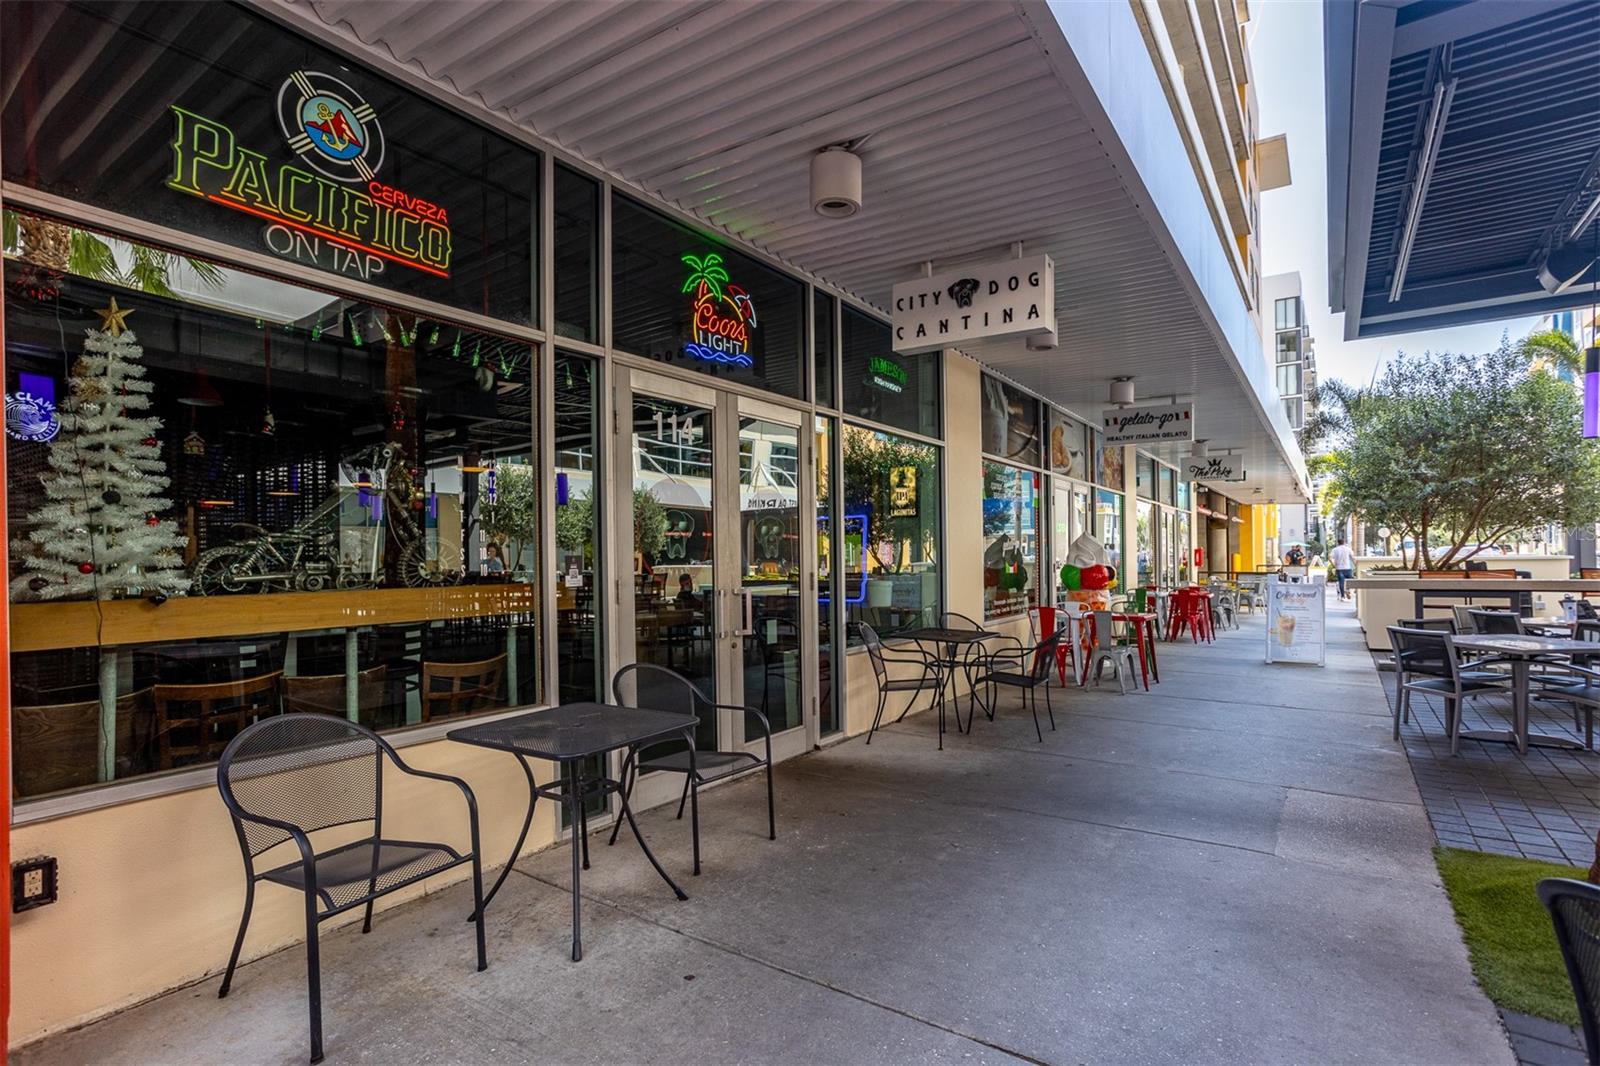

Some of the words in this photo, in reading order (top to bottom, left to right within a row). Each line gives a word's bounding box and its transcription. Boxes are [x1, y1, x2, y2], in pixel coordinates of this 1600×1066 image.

[168, 105, 452, 270] PACIFICO
[368, 180, 449, 223] CERVEZA
[266, 224, 319, 264] ON
[325, 240, 385, 280] TAP
[896, 290, 942, 312] CITY
[989, 272, 1039, 295] DOG
[697, 303, 748, 341] Coors
[896, 303, 1040, 341] CANTINA
[699, 329, 742, 355] LIGHT
[15, 391, 57, 411] CLAW
[652, 412, 695, 446] 114
[1106, 434, 1134, 442] HEALTHY
[1135, 432, 1160, 440] ITALIAN
[1161, 430, 1188, 438] GELATO
[1119, 412, 1175, 433] gelato-go
[460, 528, 466, 542] F
[479, 528, 486, 542] 11
[459, 547, 466, 561] S
[479, 546, 488, 560] 10
[460, 564, 467, 578] S
[480, 563, 490, 577] 10
